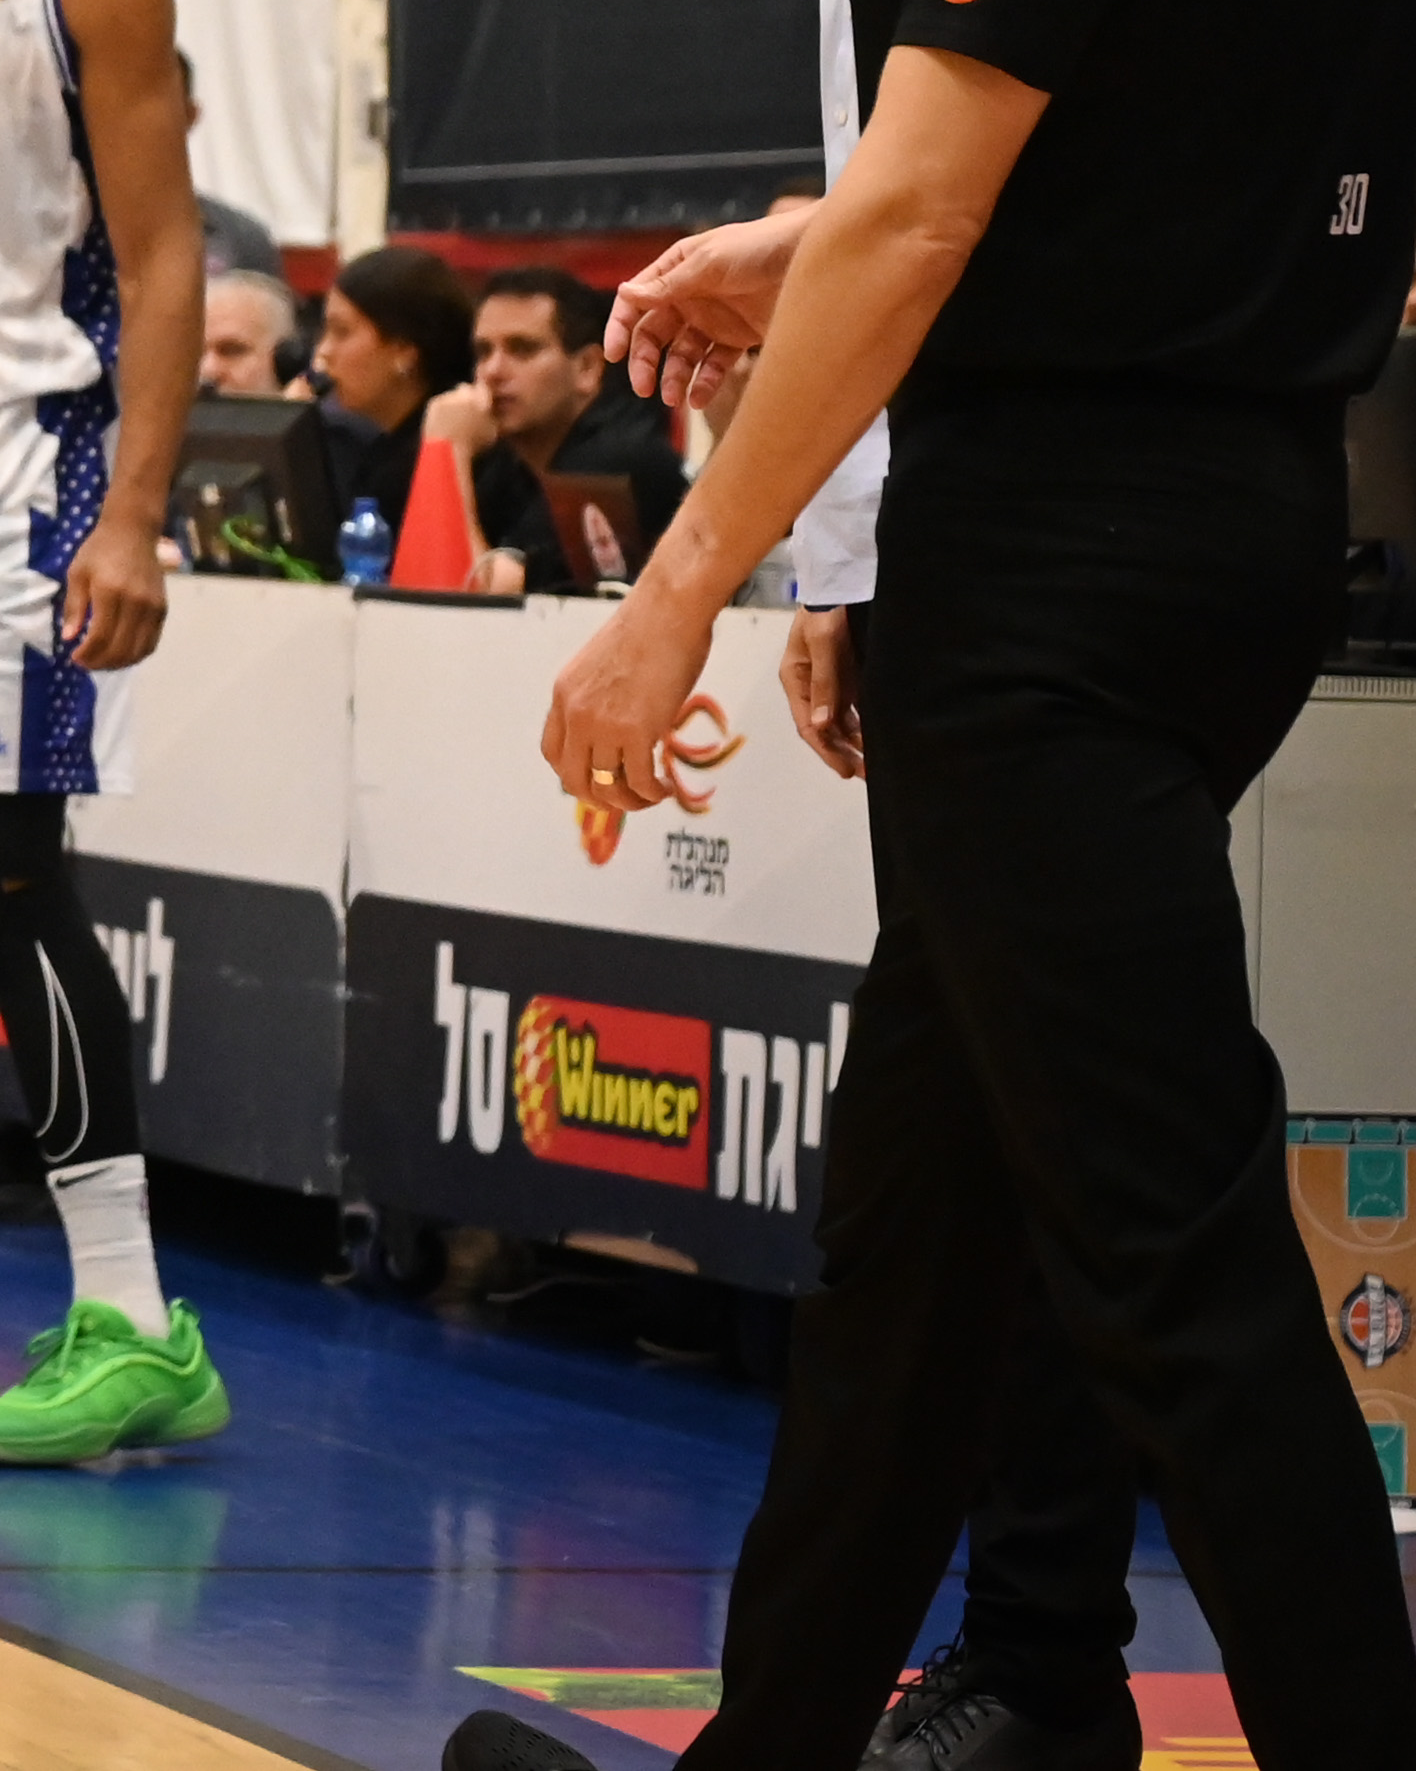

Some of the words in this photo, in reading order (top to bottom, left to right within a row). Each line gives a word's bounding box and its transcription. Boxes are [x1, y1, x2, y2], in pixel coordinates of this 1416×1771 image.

[1328, 173, 1370, 236] 30
[434, 940, 511, 1155] סל
[555, 1023, 700, 1141] Winner
